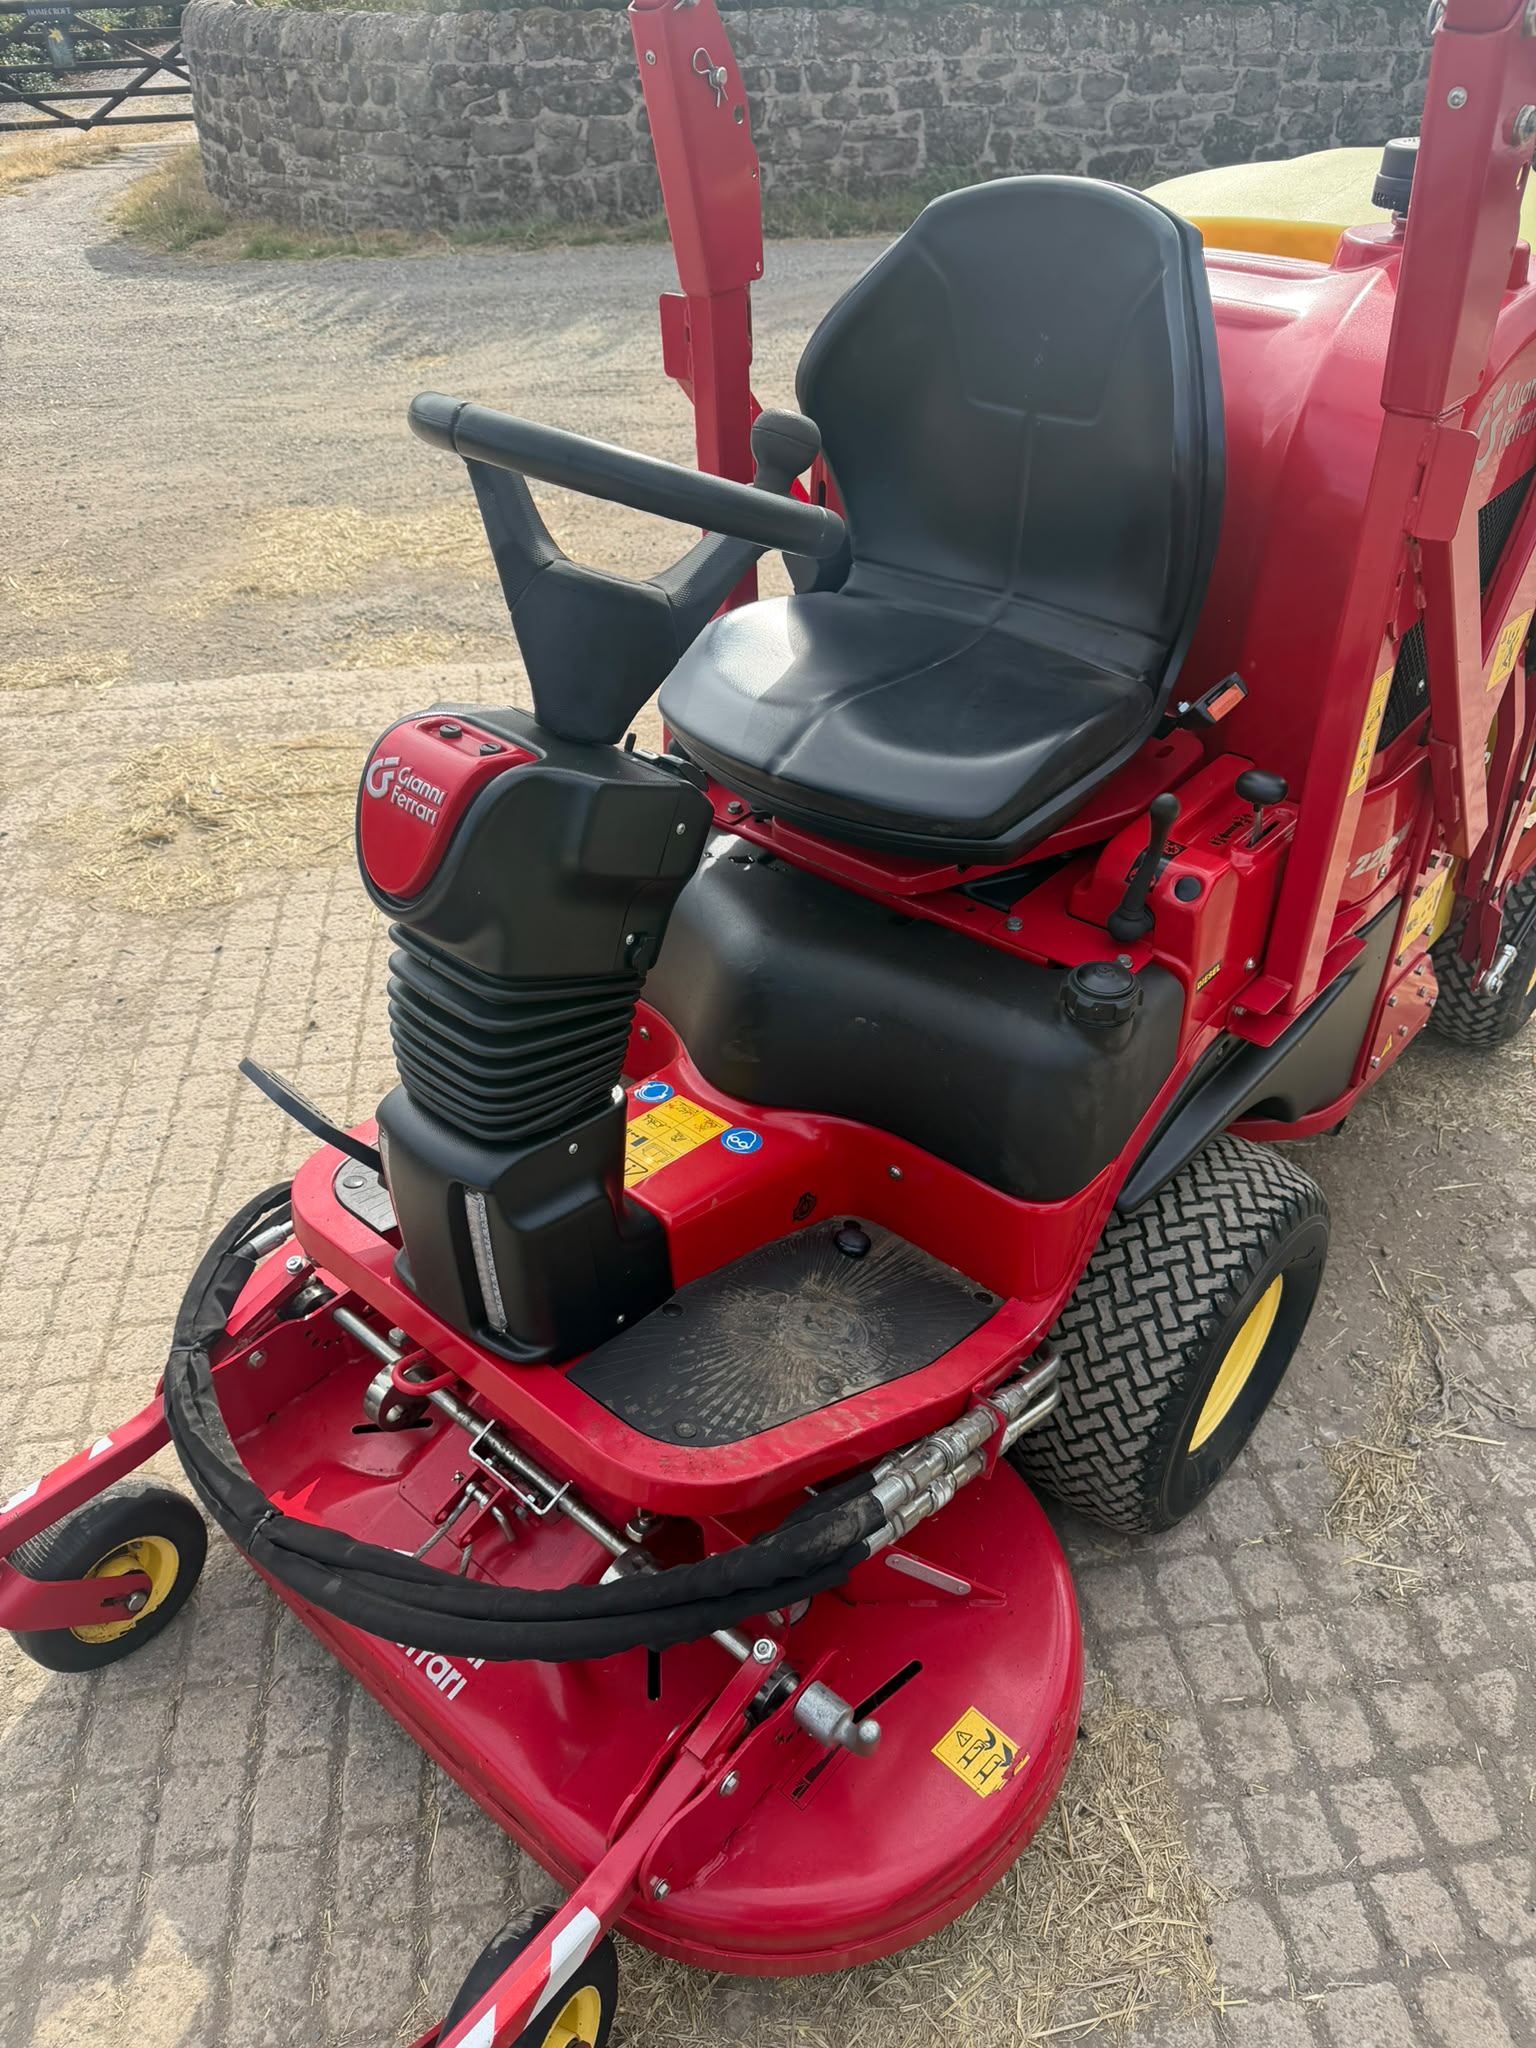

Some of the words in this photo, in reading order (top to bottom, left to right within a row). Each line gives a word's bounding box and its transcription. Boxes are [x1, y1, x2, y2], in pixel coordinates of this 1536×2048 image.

[398, 766, 445, 806] Gianni
[390, 787, 438, 826] Ferrari
[1196, 963, 1220, 991] DIESEL
[396, 1643, 468, 1701] rari
